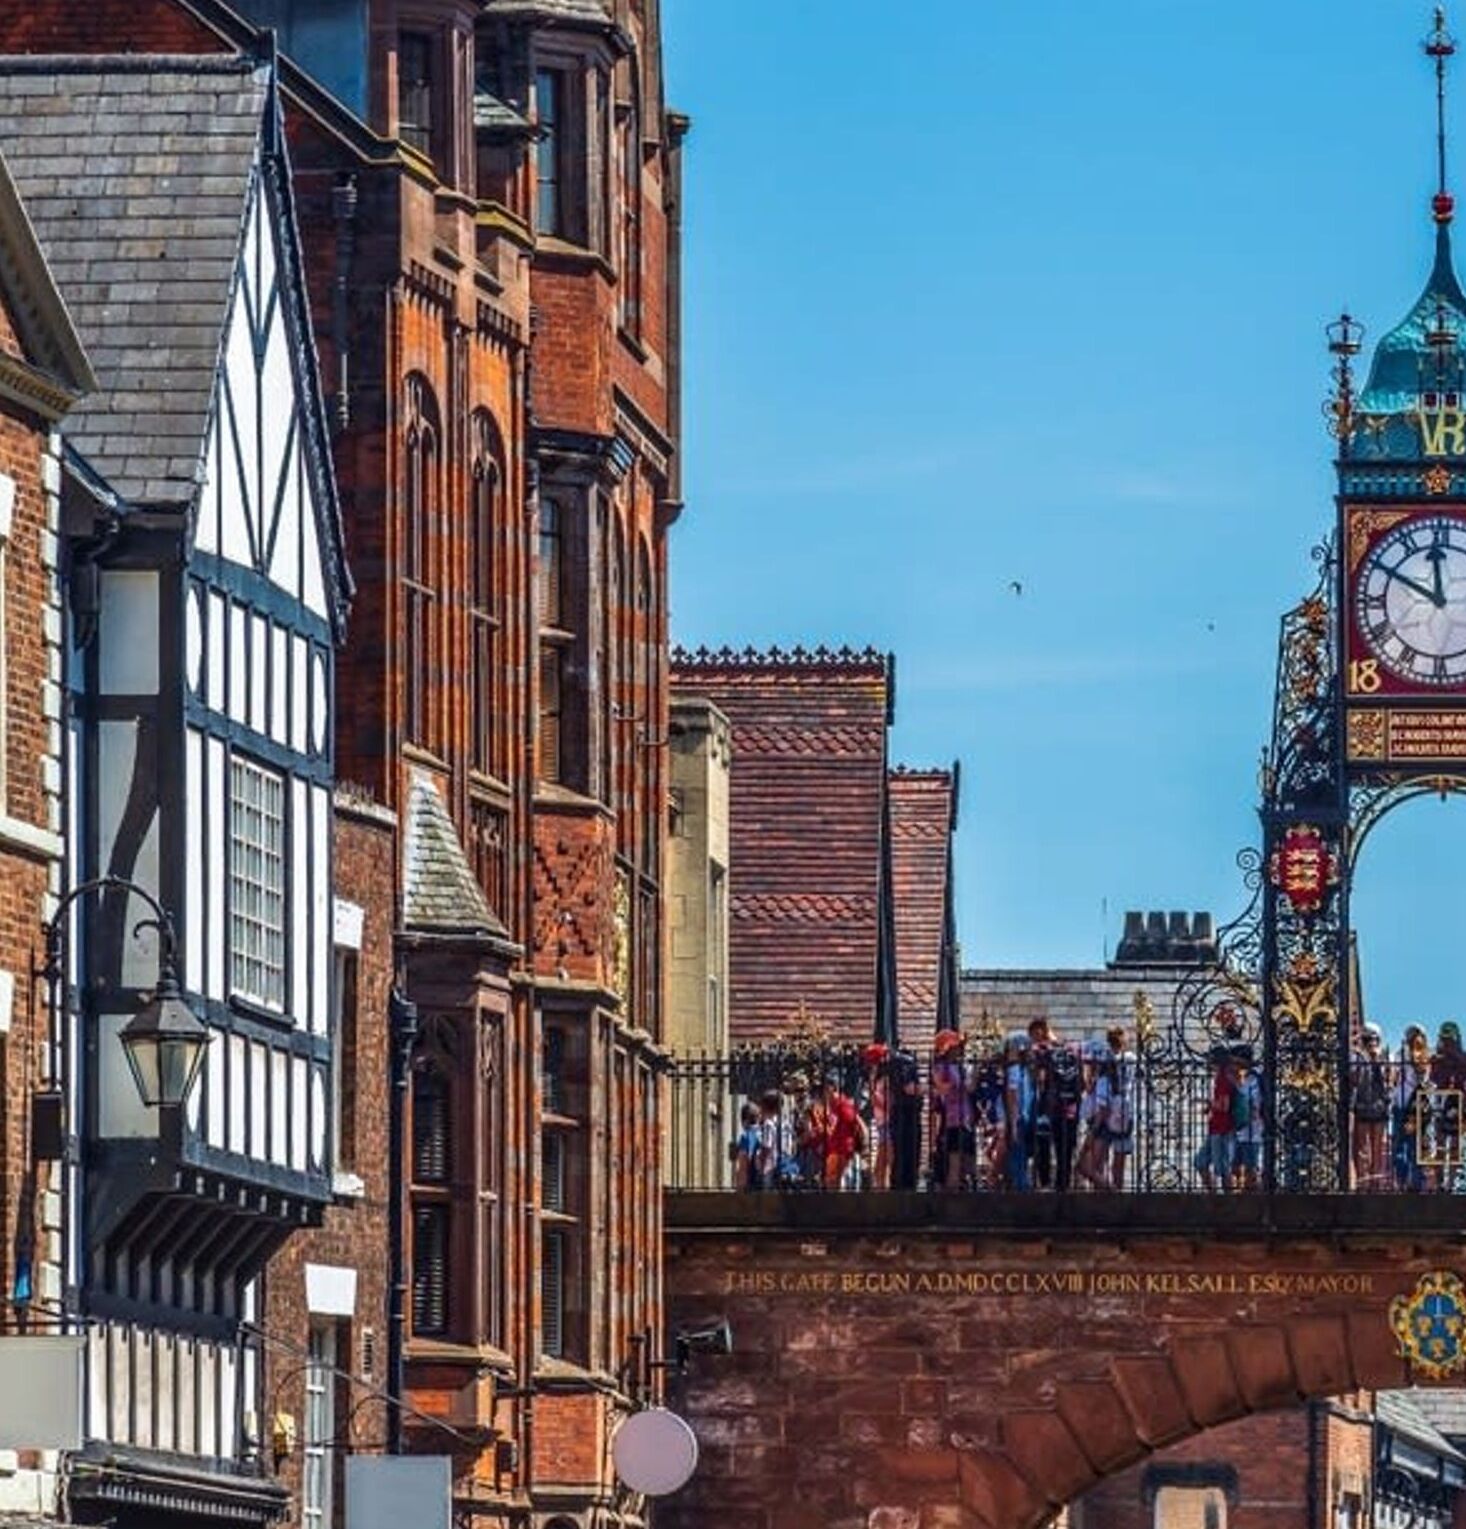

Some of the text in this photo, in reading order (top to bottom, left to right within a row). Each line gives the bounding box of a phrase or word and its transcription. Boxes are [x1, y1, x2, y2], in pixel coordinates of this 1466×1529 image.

[1349, 659, 1382, 693] 18
[842, 1270, 910, 1293] BEGUN
[1089, 1272, 1140, 1295] JOHN
